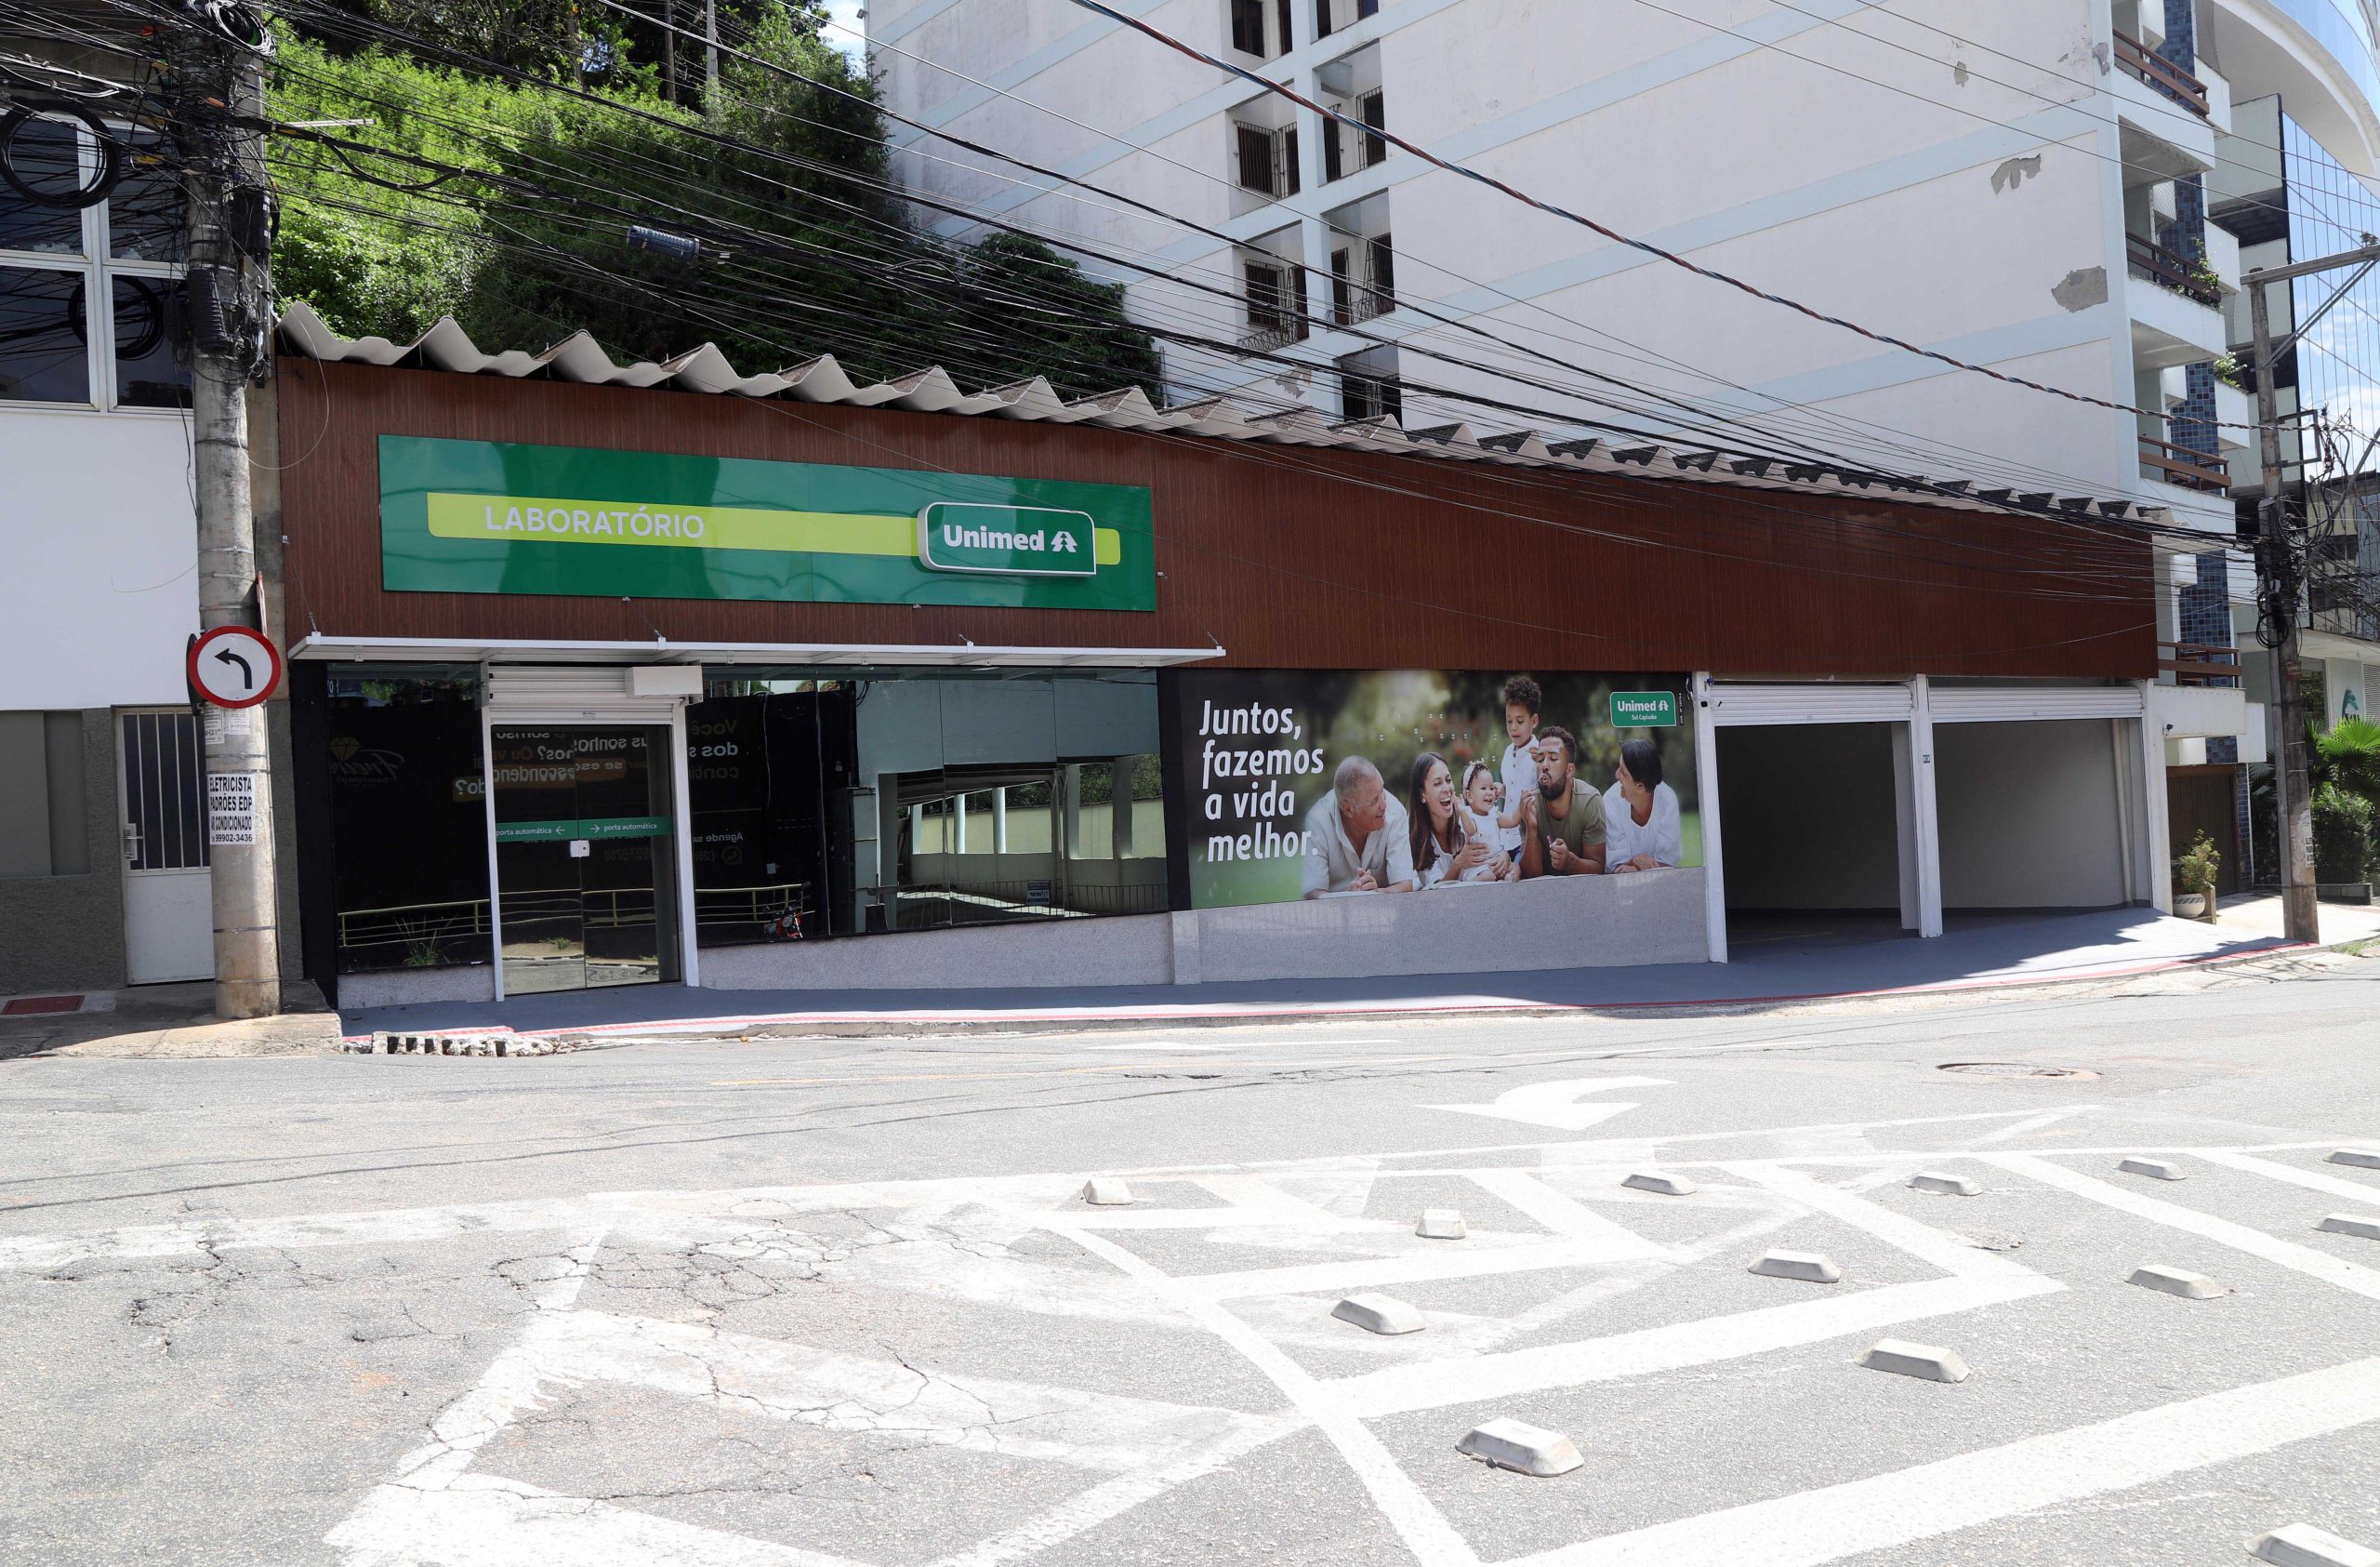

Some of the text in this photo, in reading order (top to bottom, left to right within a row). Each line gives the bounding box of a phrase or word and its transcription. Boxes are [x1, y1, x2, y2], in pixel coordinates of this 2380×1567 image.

[485, 505, 705, 538] LABORATÓRIO
[943, 525, 1045, 551] Unimed
[1617, 699, 1657, 712] Unimed
[1198, 699, 1302, 740] Juntos,
[1202, 739, 1324, 790] fazemos
[209, 777, 252, 791] ELETRICISTA
[210, 793, 253, 812] PADRÕES EDP
[1205, 779, 1295, 820] a vida
[216, 815, 252, 830] CONDICIONADO
[514, 827, 552, 836] automática
[603, 822, 657, 832] porta automática
[215, 833, 253, 843] 99902-3436
[1207, 821, 1318, 862] melhor.
